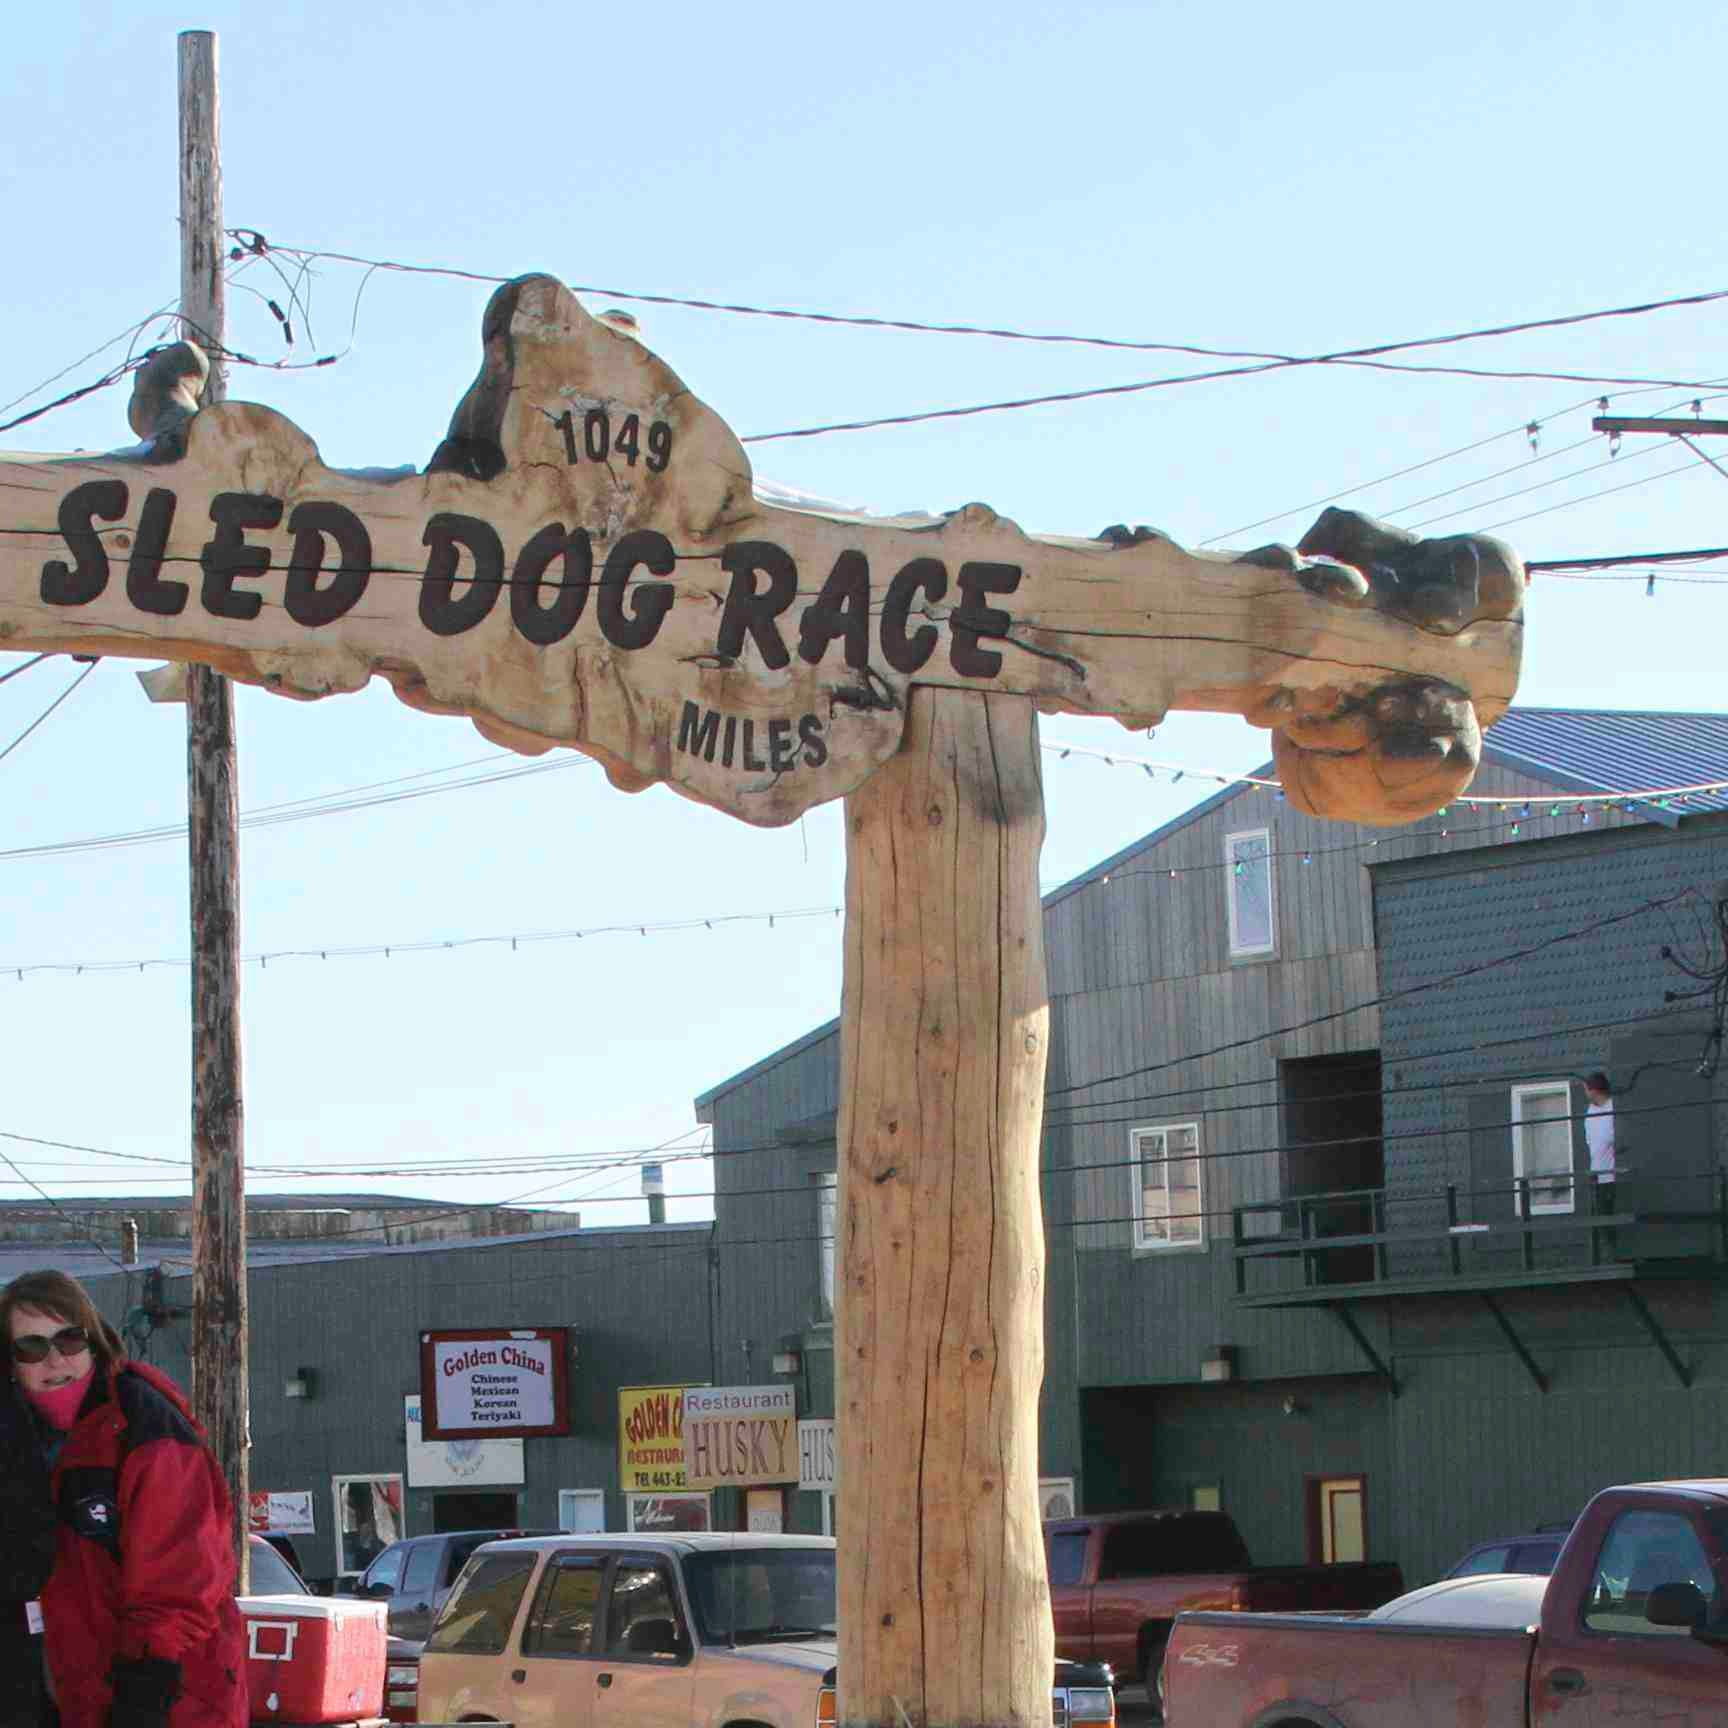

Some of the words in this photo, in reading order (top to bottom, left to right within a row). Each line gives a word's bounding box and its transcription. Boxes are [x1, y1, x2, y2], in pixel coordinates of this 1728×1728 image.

[555, 410, 672, 472] 1049
[41, 479, 372, 627] SLED
[419, 512, 675, 650] DOG
[719, 540, 1021, 678] RACE
[677, 701, 828, 772] MILES
[443, 1348, 497, 1377] Golden
[501, 1346, 545, 1376] China
[471, 1374, 518, 1384] Chinese
[471, 1386, 520, 1397] Mexican
[470, 1411, 522, 1422] Teriyaki
[473, 1399, 518, 1409] Korean
[688, 1391, 791, 1411] Restaurant
[625, 1392, 669, 1445] GOLDEN
[692, 1419, 788, 1478] HUSKY
